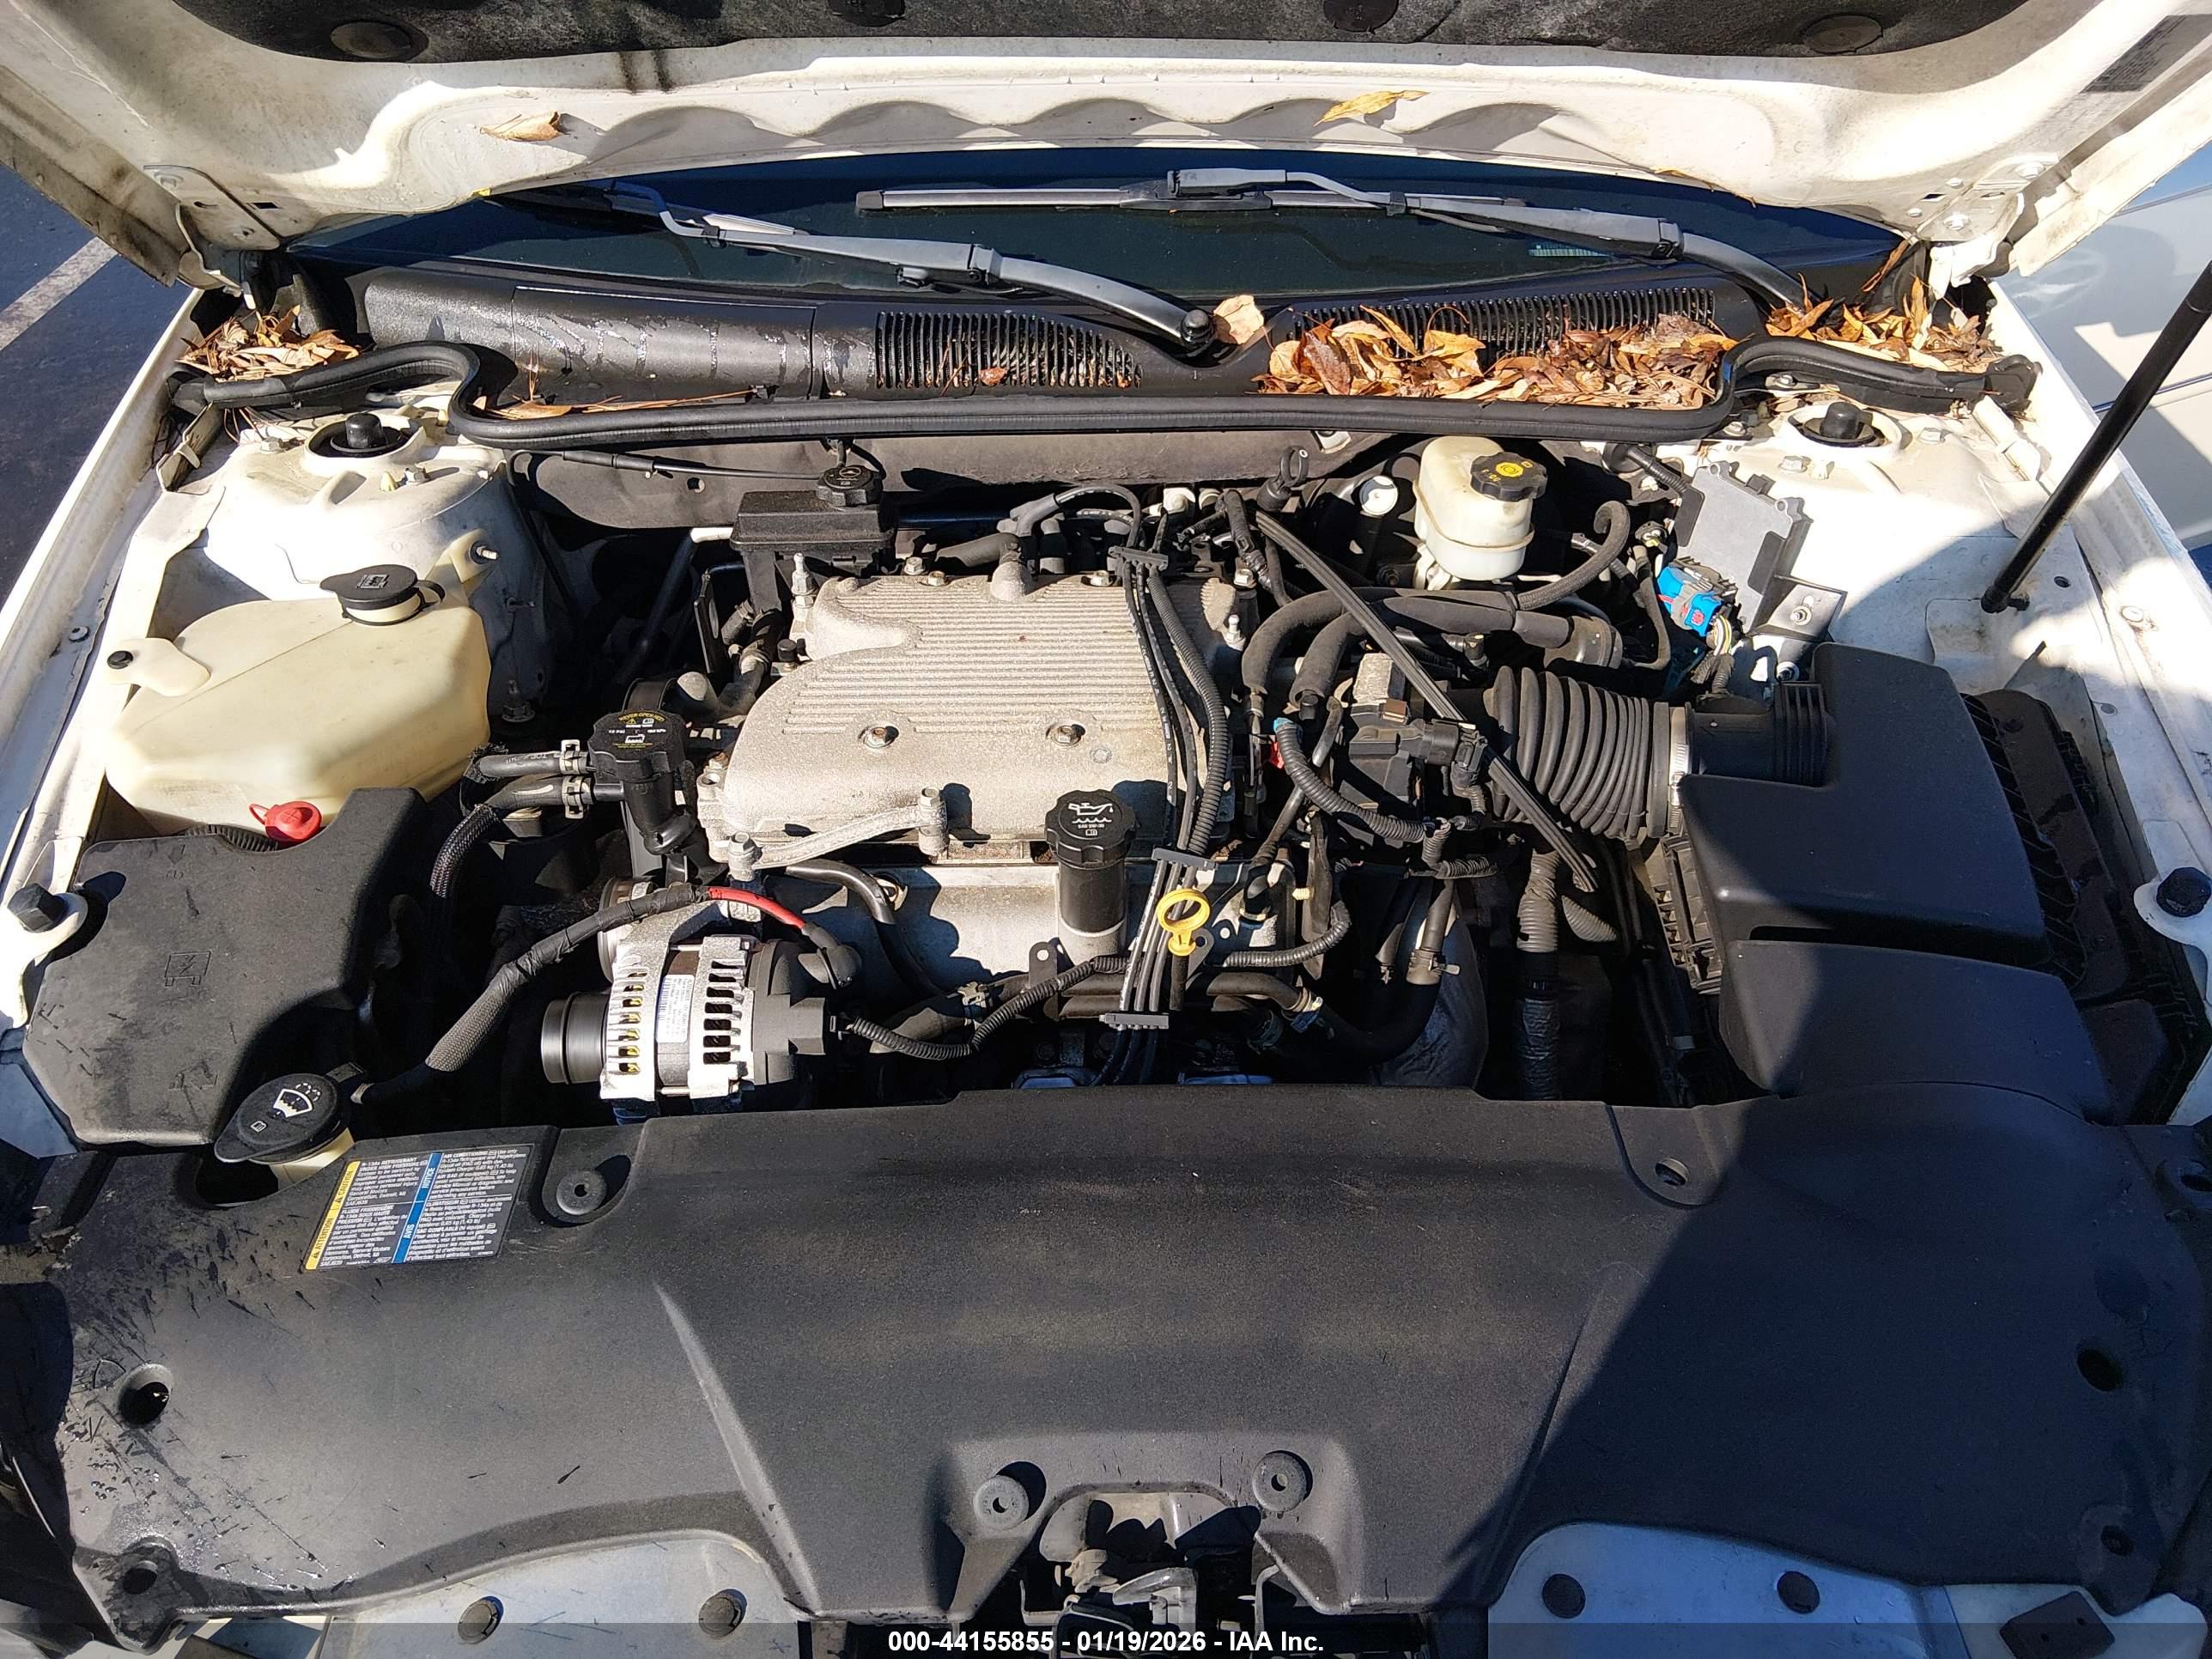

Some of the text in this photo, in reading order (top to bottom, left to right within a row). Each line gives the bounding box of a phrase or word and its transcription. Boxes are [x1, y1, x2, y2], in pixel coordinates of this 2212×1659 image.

[338, 1170, 353, 1194] CAUTION
[422, 1166, 436, 1188] NOTICE
[314, 1218, 333, 1249] ATTENTION
[402, 1224, 415, 1238] AVIS
